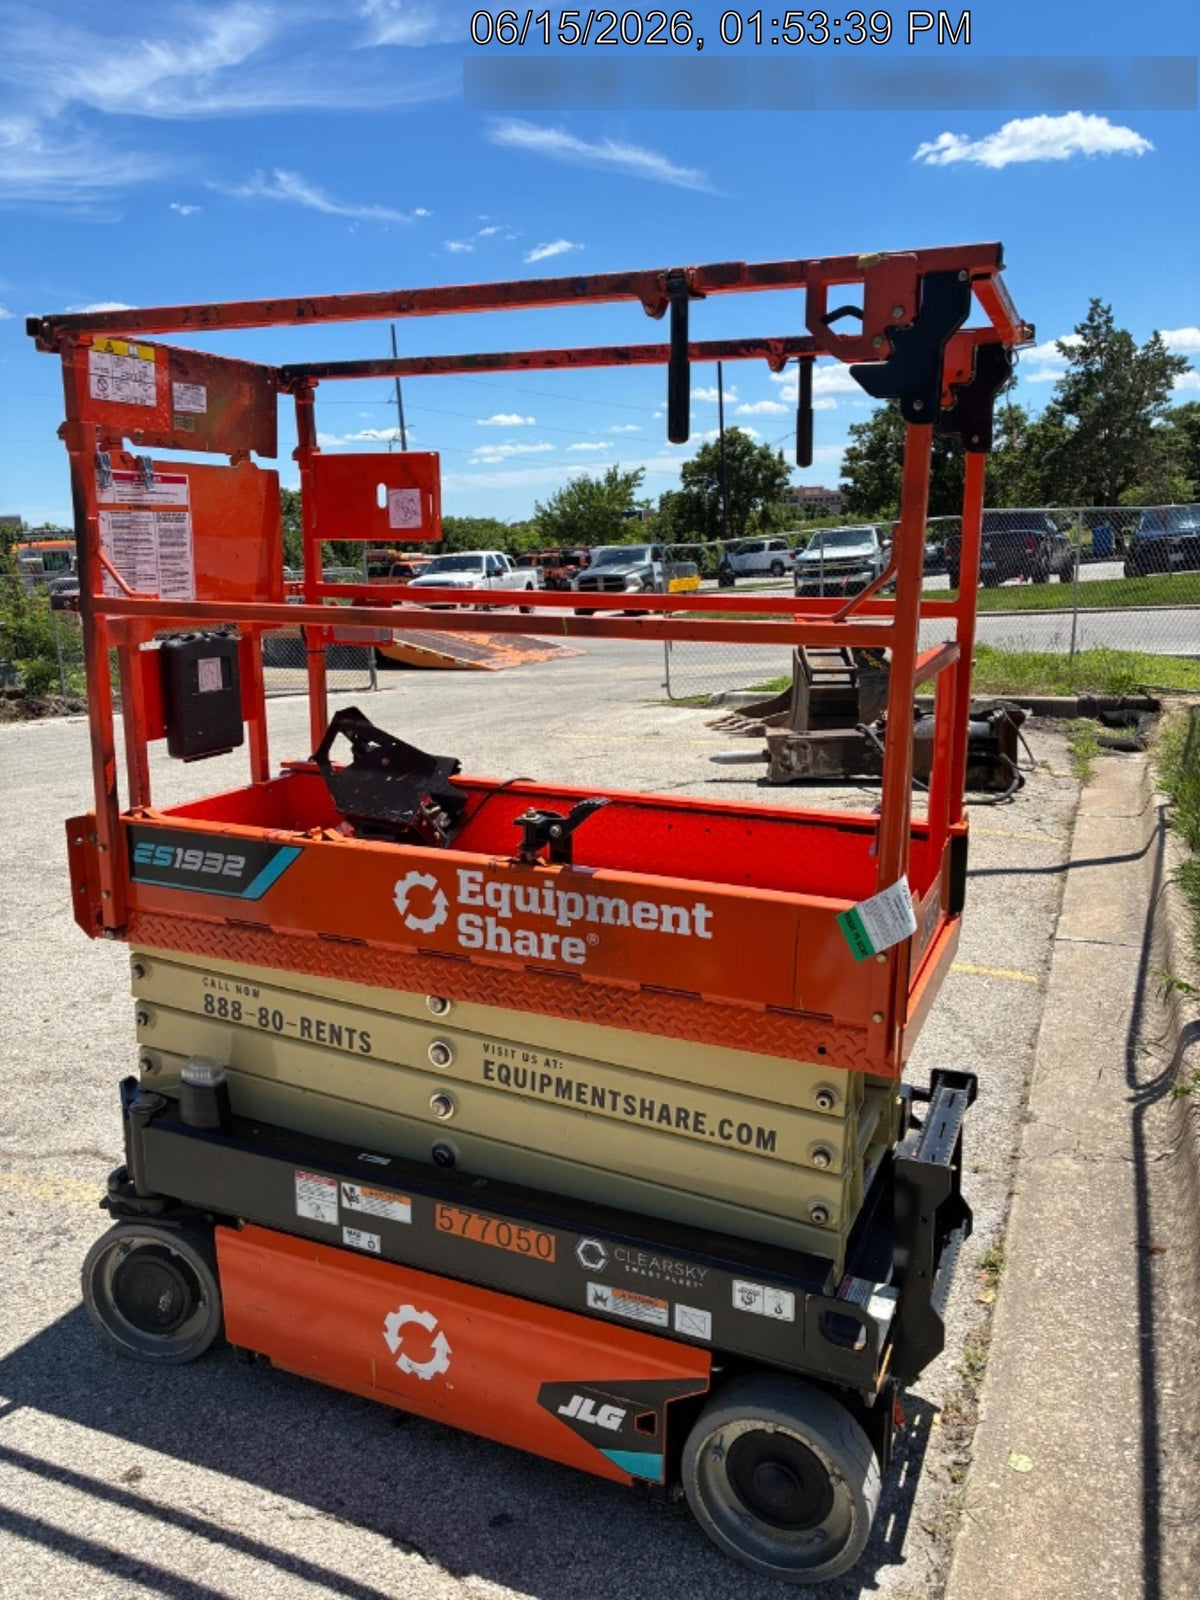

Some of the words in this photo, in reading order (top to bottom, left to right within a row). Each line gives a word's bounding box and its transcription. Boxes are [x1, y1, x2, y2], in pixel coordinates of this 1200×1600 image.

[133, 842, 246, 878] ES1932
[456, 869, 713, 939] Equipment
[202, 977, 230, 992] CALL
[235, 984, 260, 999] NOW
[203, 993, 372, 1053] 888-80-RENTS
[482, 1043, 516, 1060] VISIT
[522, 1052, 538, 1065] US
[543, 1058, 563, 1070] AT:
[483, 1059, 777, 1153] EQUIPMENTSHARE.COM
[439, 1205, 552, 1258] 577050
[614, 1247, 708, 1280] CLEARSKY
[557, 1394, 627, 1433] JLG
